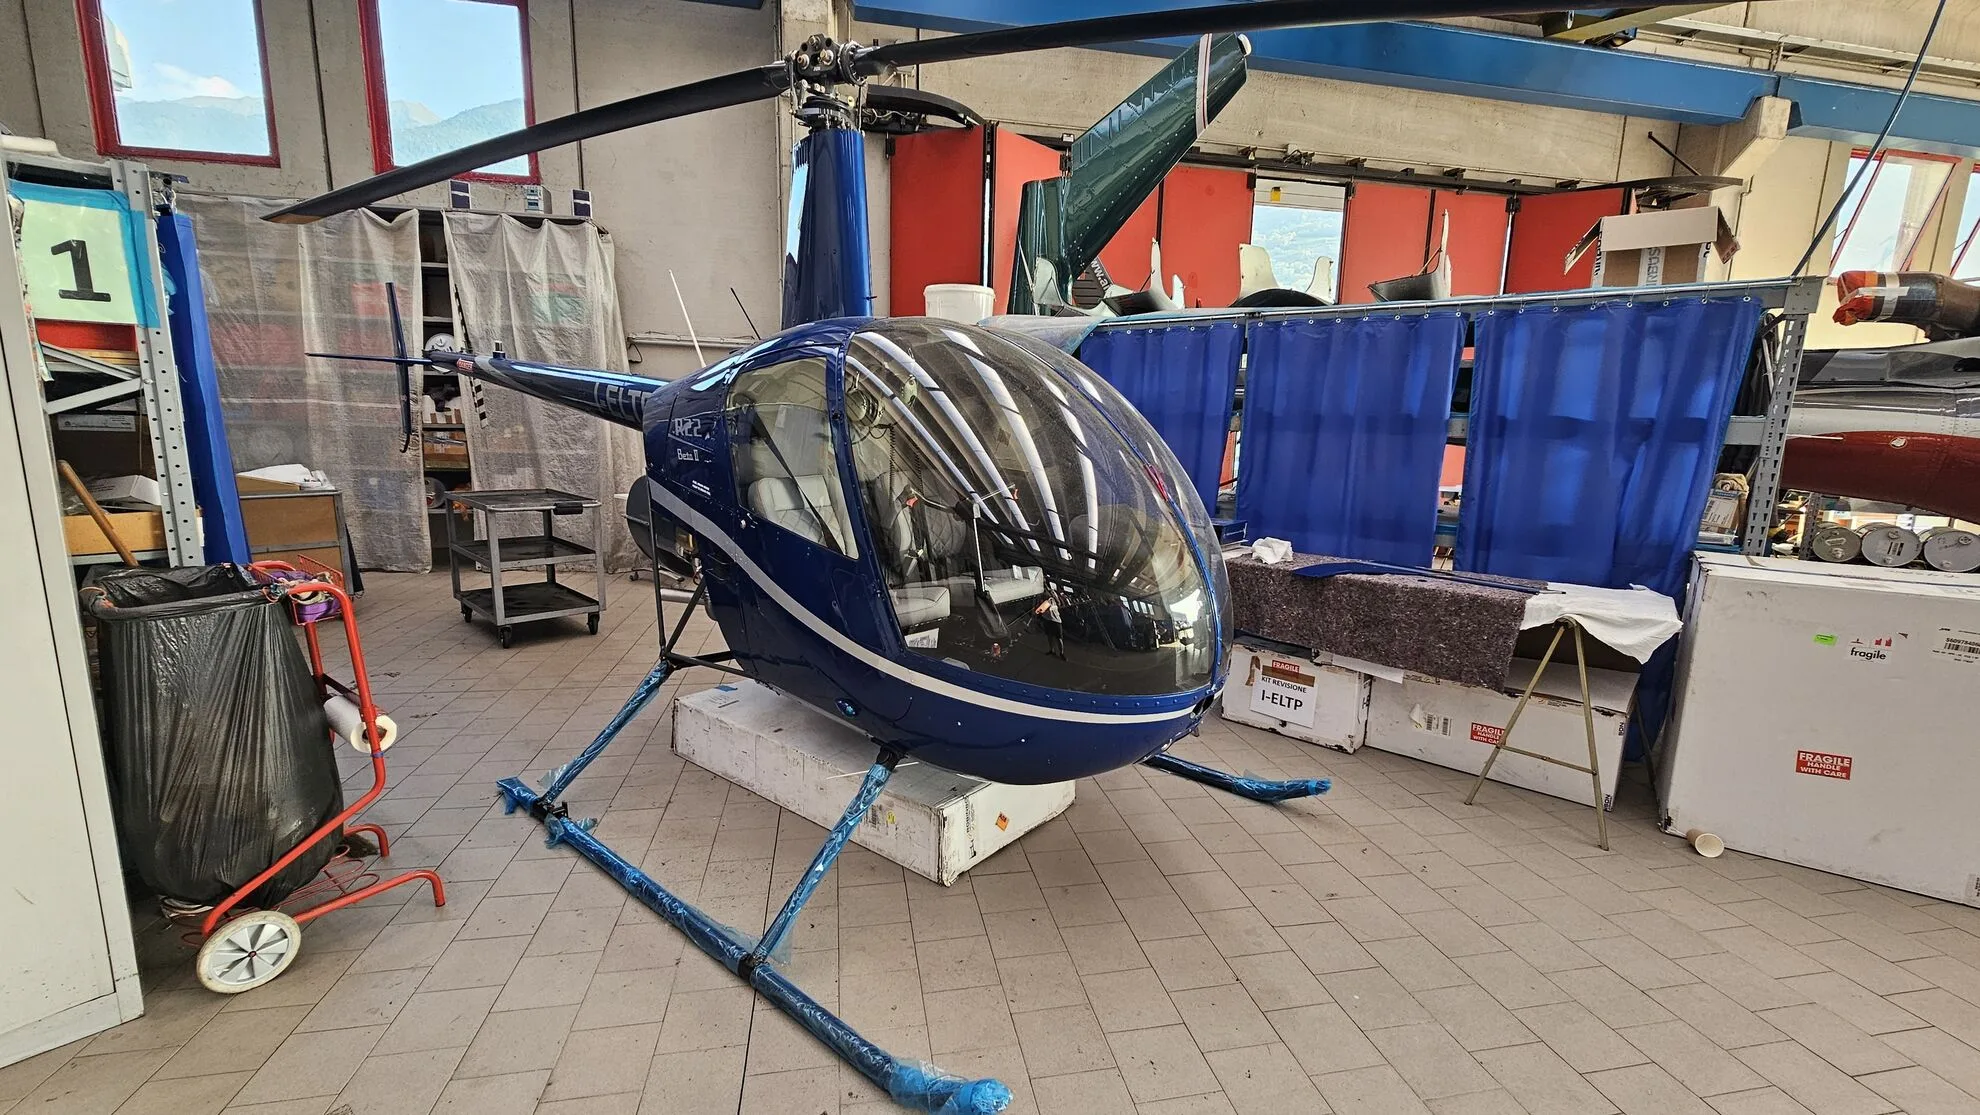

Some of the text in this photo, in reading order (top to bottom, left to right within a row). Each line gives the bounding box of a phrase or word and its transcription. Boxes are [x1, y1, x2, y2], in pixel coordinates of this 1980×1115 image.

[50, 239, 111, 302] 1
[674, 418, 702, 437] R22
[677, 448, 694, 461] Beta
[1850, 647, 1887, 660] fragile
[1272, 662, 1299, 672] FRAGILE
[1272, 678, 1307, 693] REVISIONE
[1261, 689, 1303, 710] I-ELTP
[1477, 731, 1499, 739] HANDLE
[1799, 752, 1851, 767] FRAGILE
[1807, 761, 1841, 771] HANDLE
[1800, 766, 1847, 778] WITH CARE
